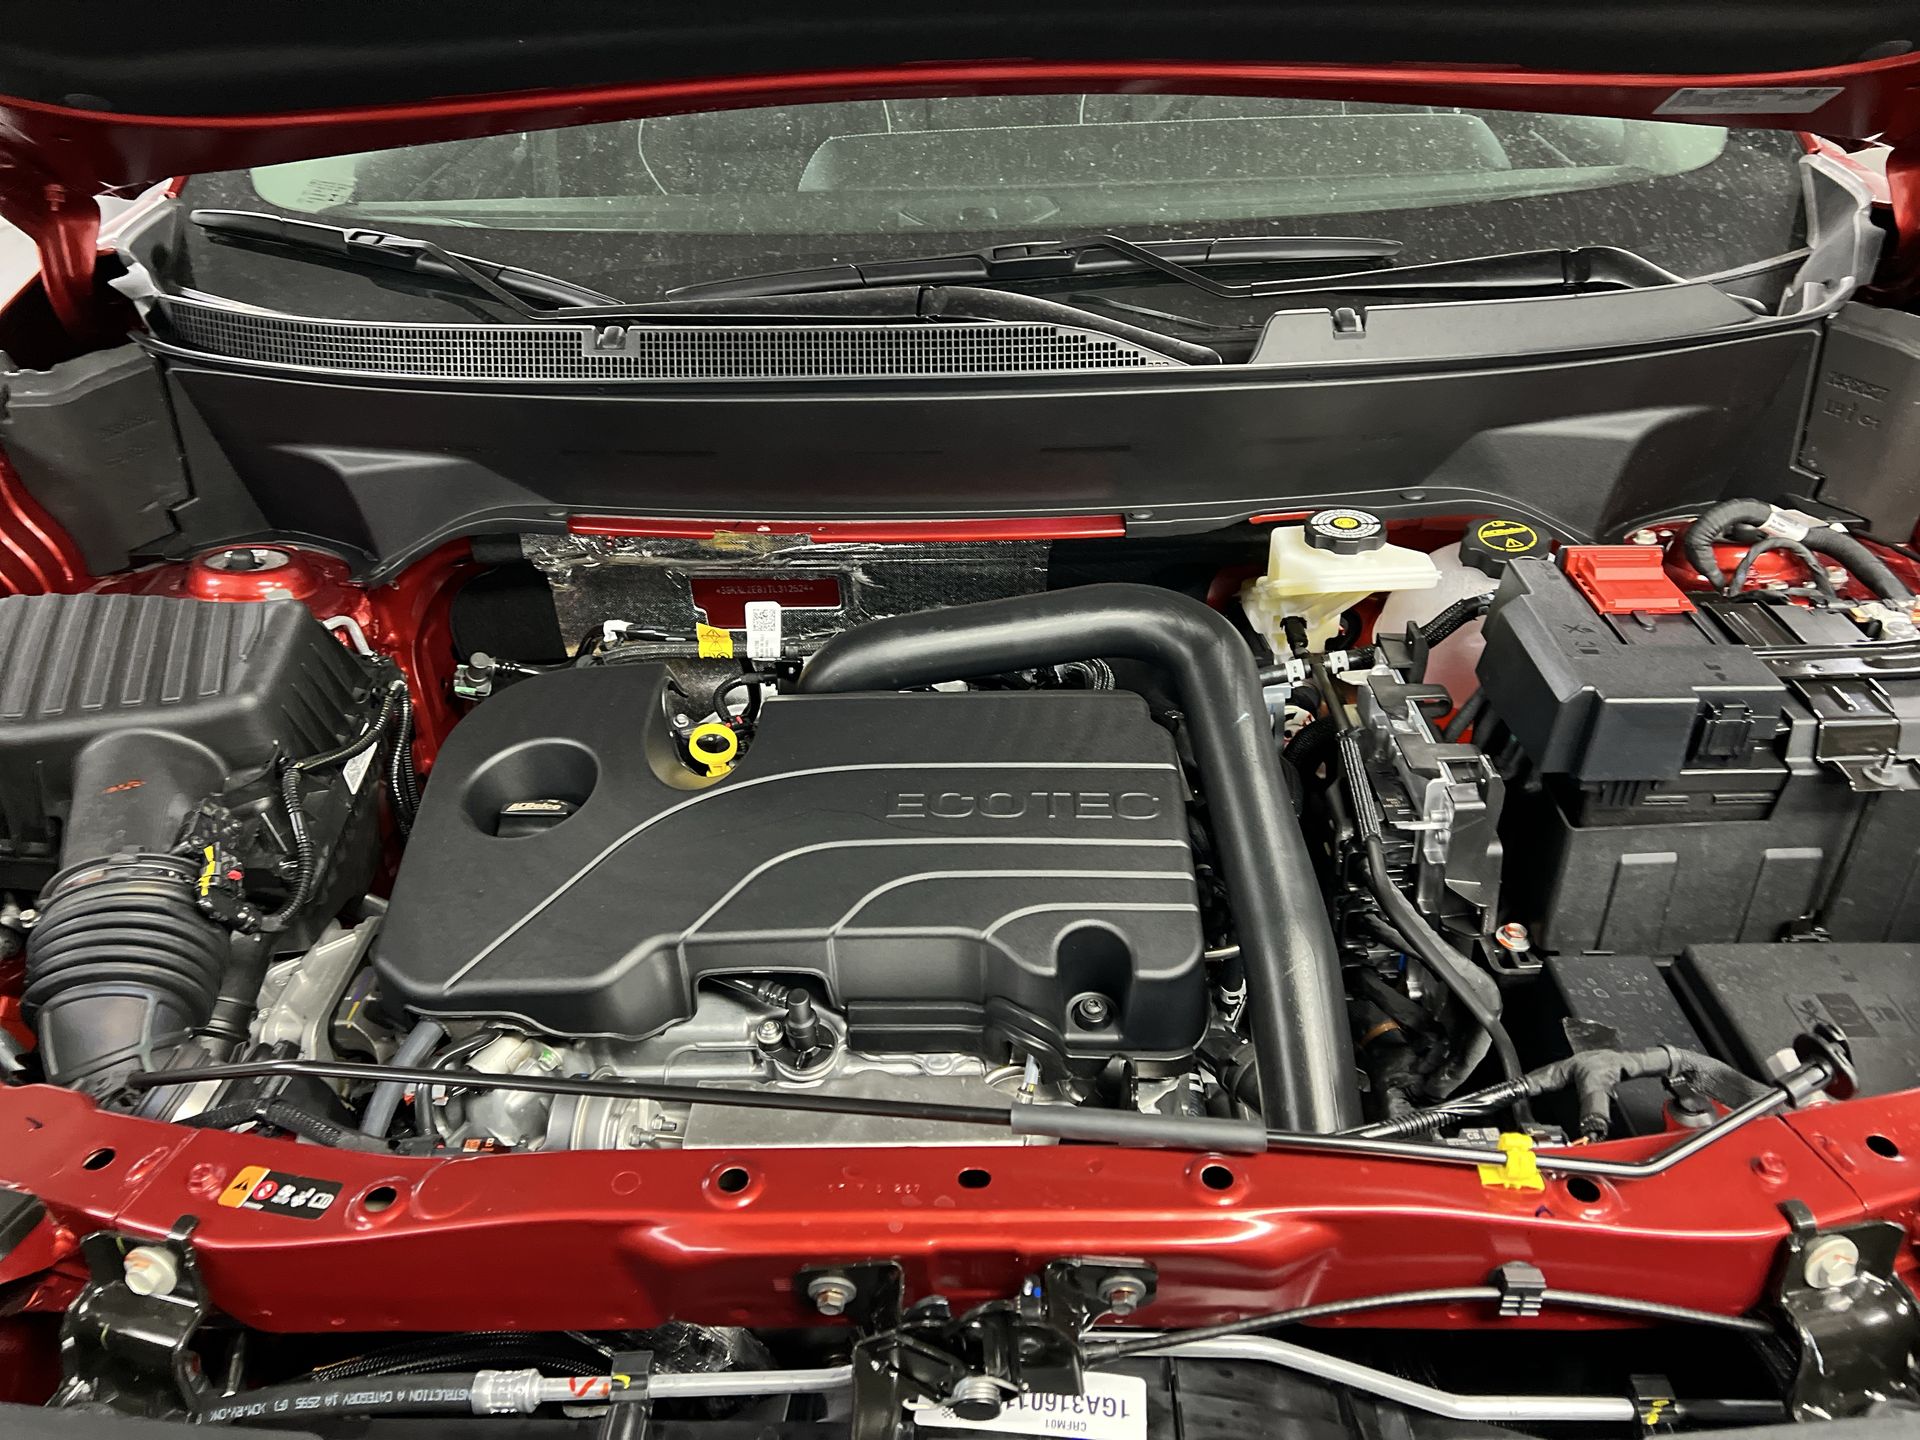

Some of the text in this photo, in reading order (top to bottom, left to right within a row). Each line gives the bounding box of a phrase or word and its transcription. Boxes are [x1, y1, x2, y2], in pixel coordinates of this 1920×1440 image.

[886, 792, 1161, 820] ECOTEC
[343, 1390, 393, 1406] CATEGORY
[397, 1390, 406, 1401] A
[1045, 1418, 1087, 1432] CRFM01
